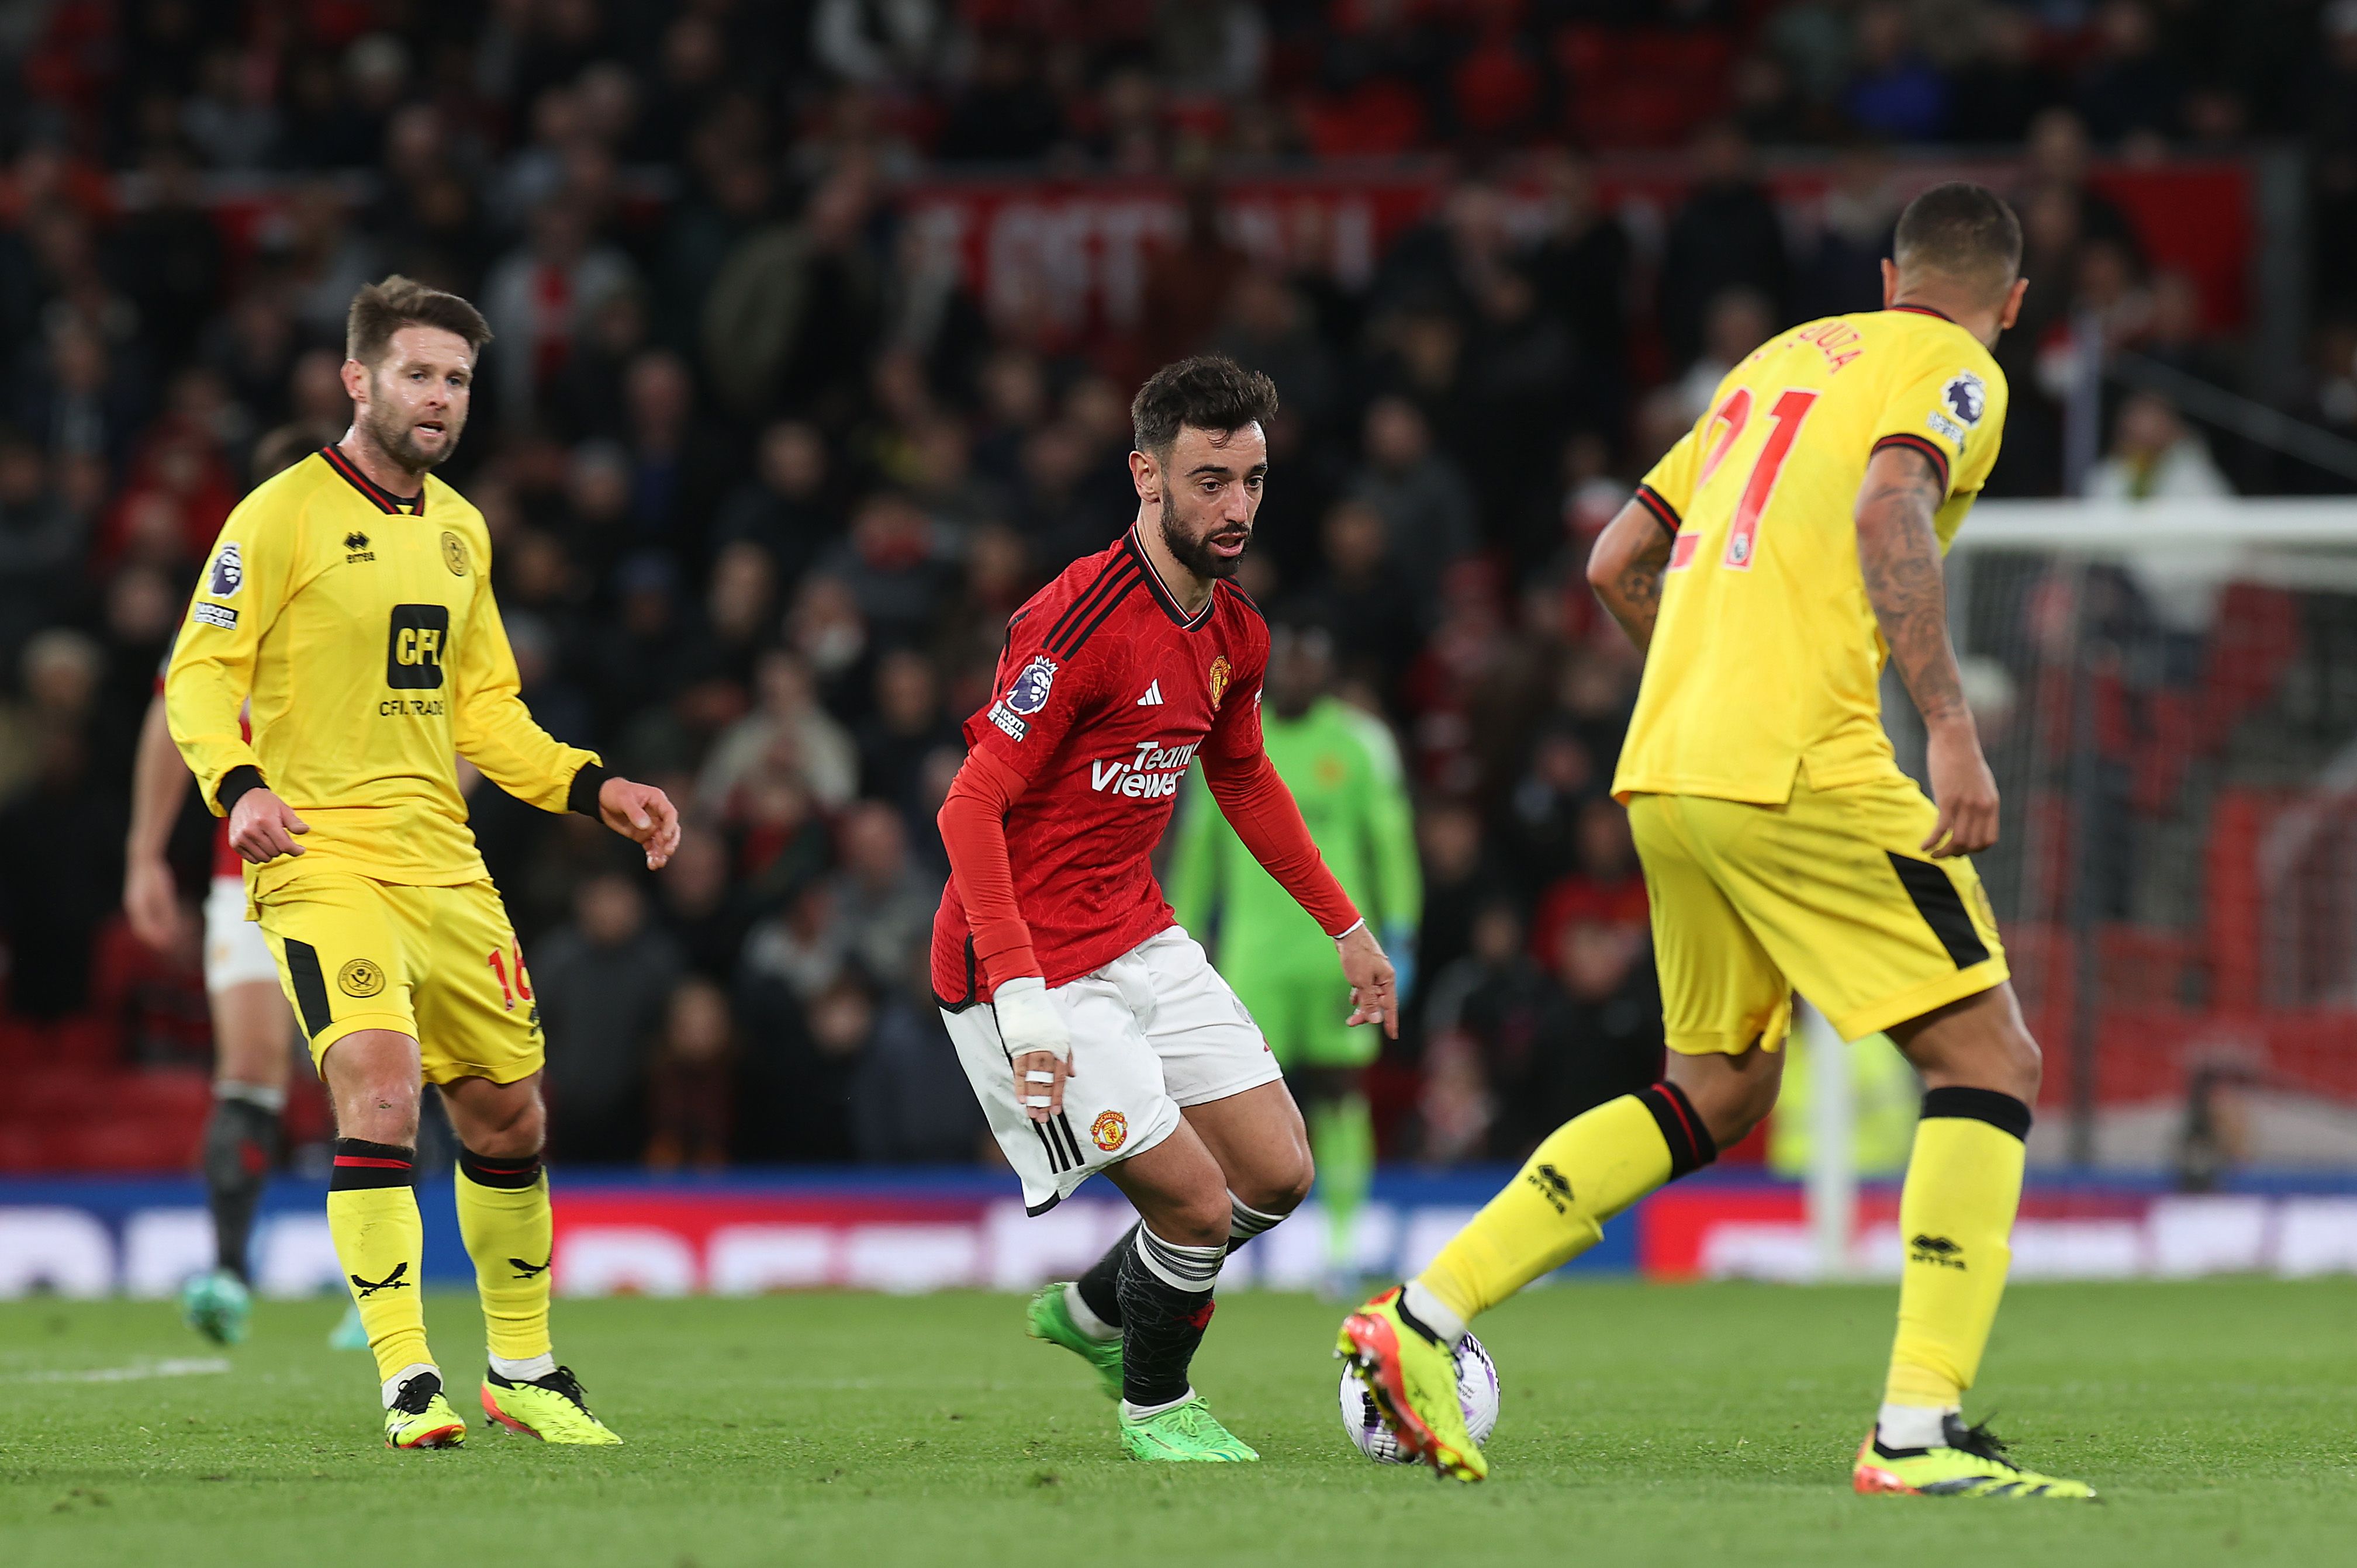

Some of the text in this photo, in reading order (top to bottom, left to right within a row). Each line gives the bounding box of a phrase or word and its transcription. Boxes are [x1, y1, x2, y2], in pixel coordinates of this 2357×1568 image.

[994, 716, 1024, 742] racism
[999, 708, 1025, 732] room
[1133, 741, 1195, 771] Team
[1091, 759, 1186, 798] Viewer
